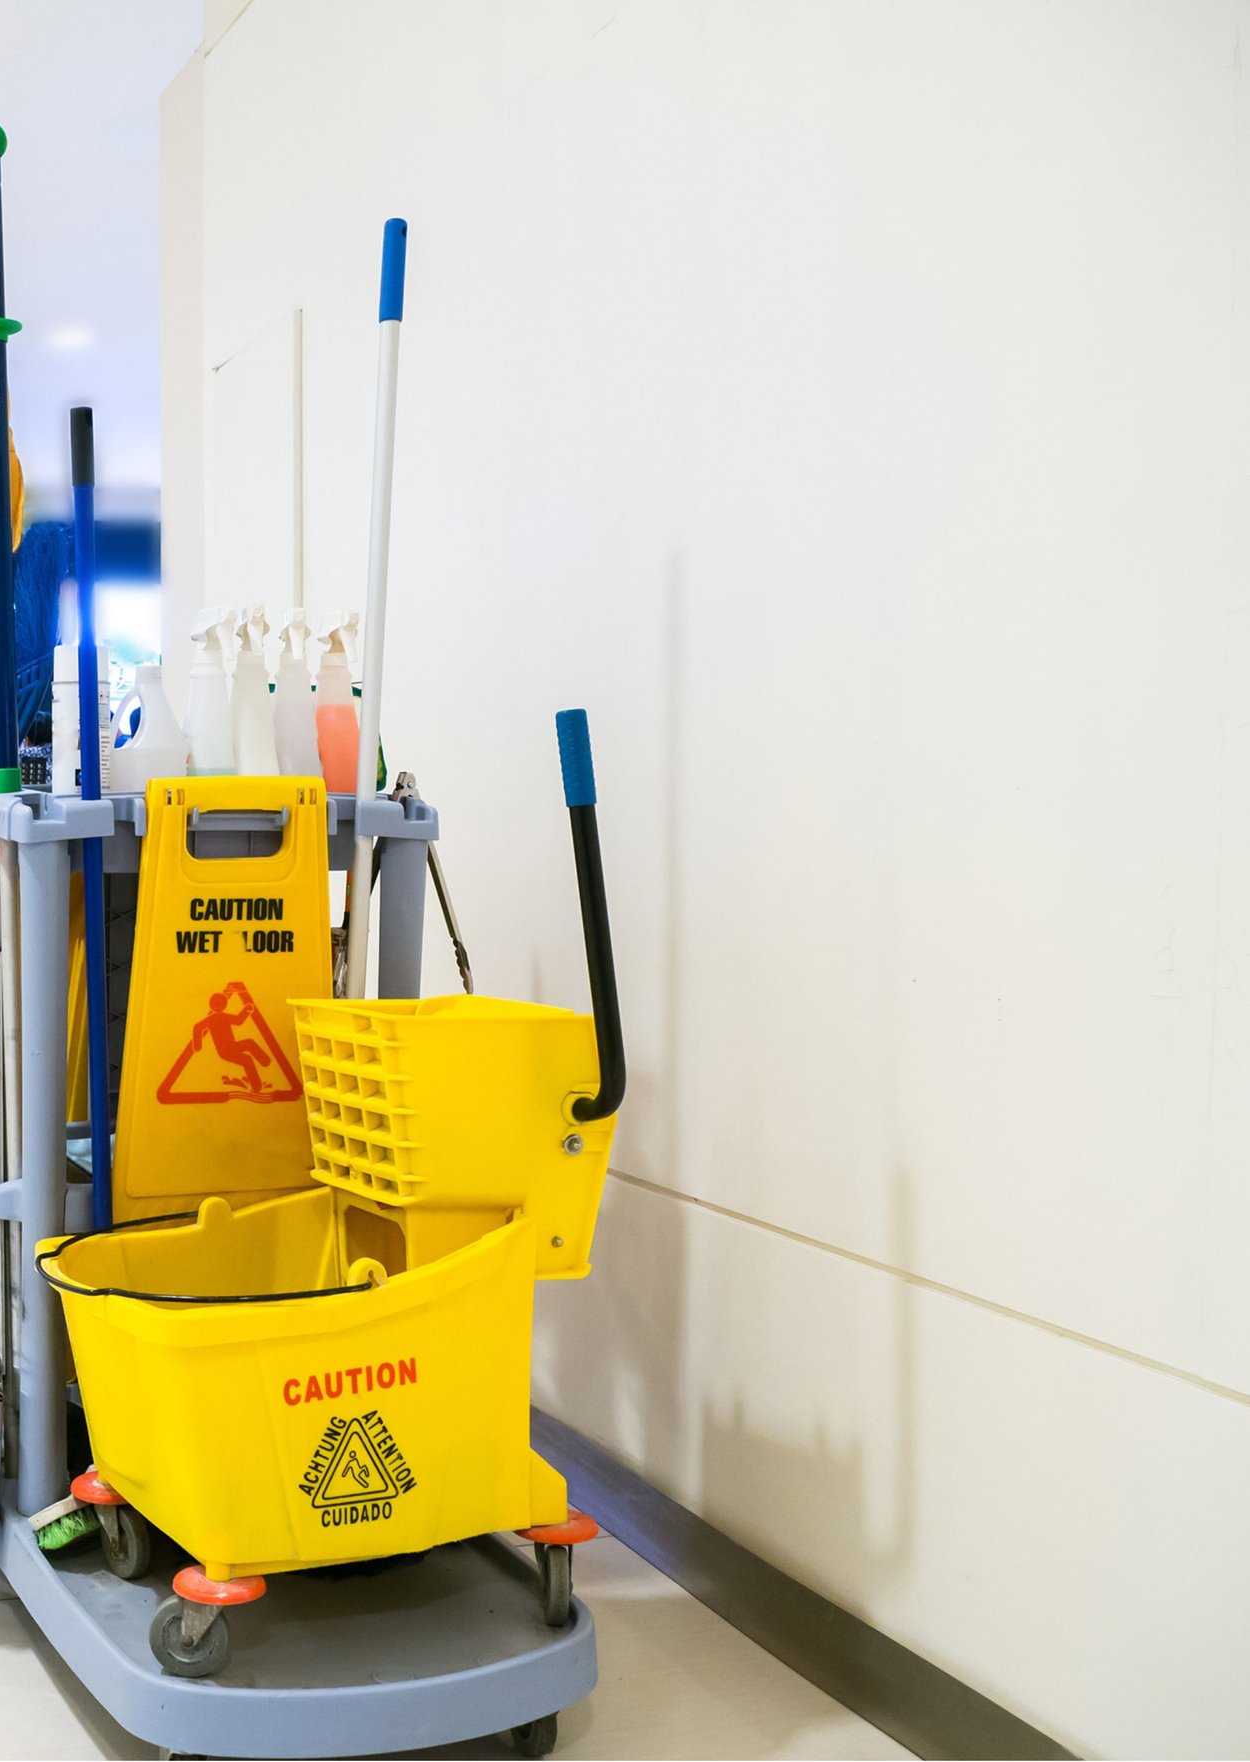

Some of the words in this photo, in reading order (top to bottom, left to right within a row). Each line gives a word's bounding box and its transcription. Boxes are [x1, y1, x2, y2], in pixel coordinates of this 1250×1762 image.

[190, 898, 283, 921] CAUTION
[176, 931, 222, 953] WET
[234, 930, 294, 953] LOOR
[283, 1357, 417, 1406] CAUTION
[298, 1416, 347, 1496] ACHTUNG
[362, 1410, 417, 1493] ATTENTION
[321, 1501, 393, 1527] CUIDADO
